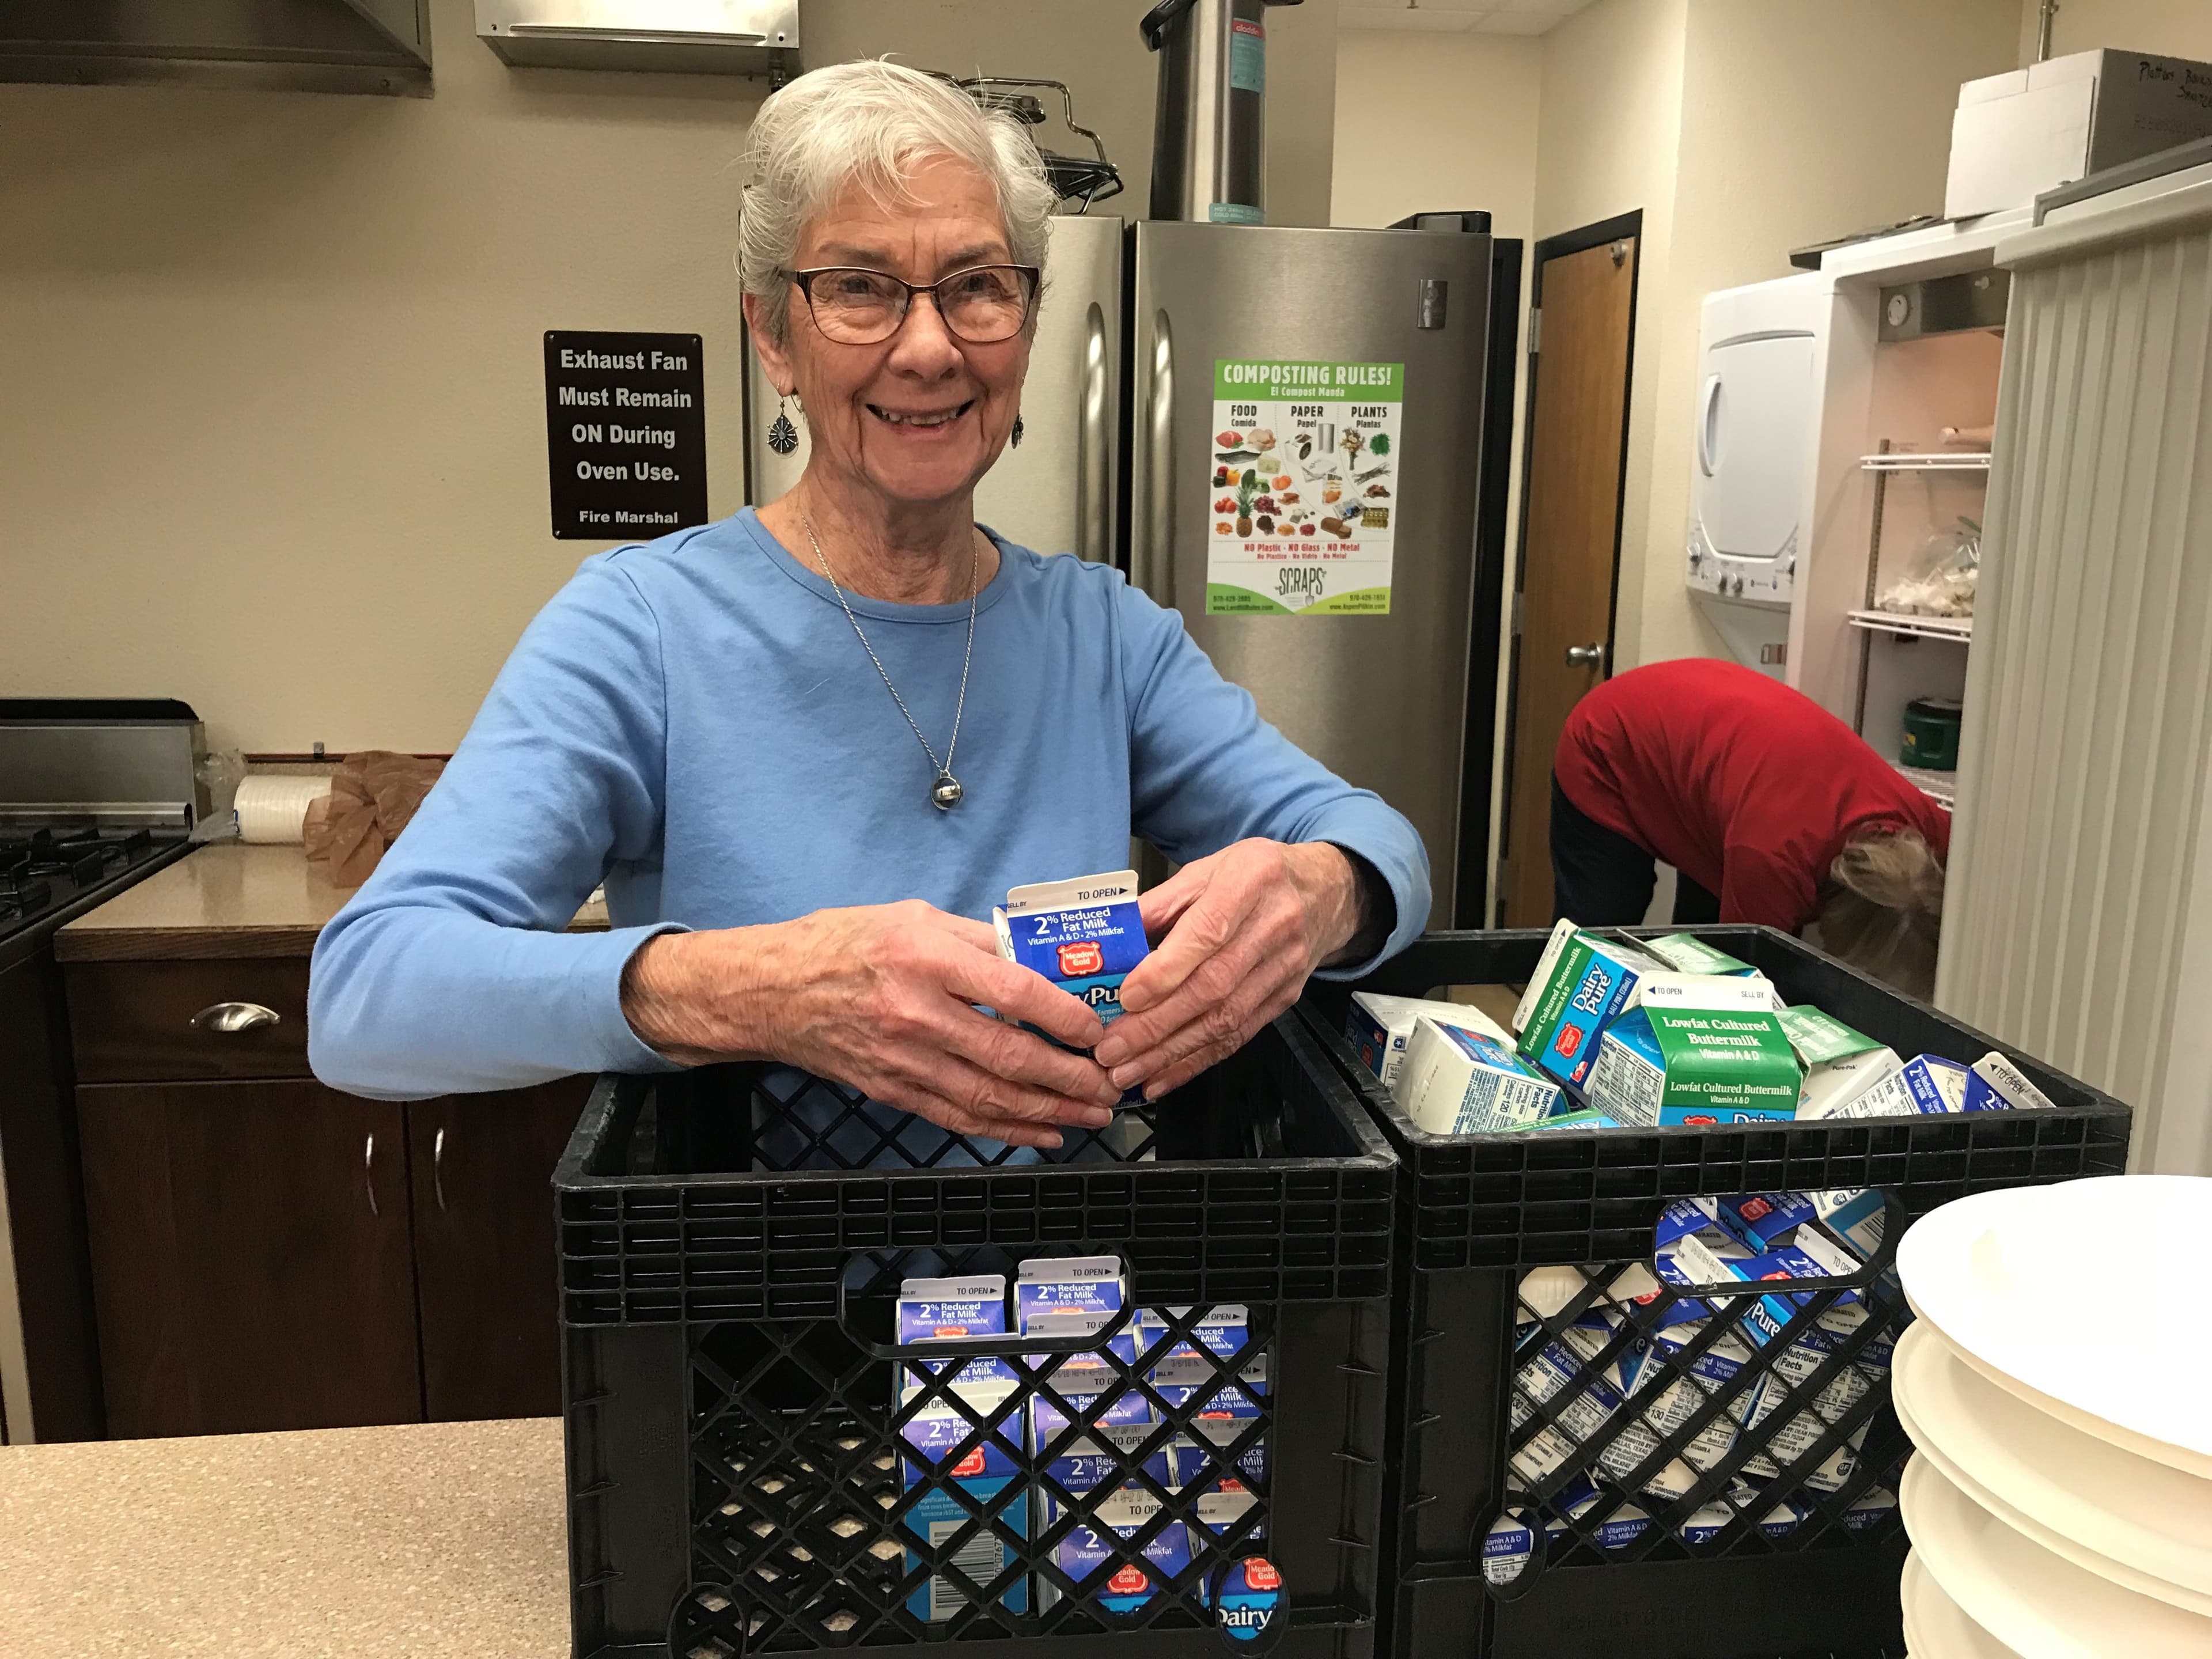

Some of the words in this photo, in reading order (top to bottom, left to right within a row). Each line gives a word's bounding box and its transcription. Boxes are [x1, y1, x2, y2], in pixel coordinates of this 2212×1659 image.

[560, 349, 645, 370] Exhaust
[651, 351, 688, 370] Fan
[1224, 365, 1329, 384] COMPOSTING
[1335, 366, 1392, 385] RULES!
[559, 387, 609, 406] Must
[616, 388, 692, 408] Remain
[1271, 388, 1279, 396] El
[1282, 388, 1316, 397] Compost
[1319, 388, 1344, 397] Manda
[1231, 405, 1257, 416] FOOD
[1291, 406, 1324, 417] PAPER
[1351, 407, 1387, 418] PLANTS
[1231, 419, 1256, 427] Comida
[1297, 420, 1316, 428] Papel
[1356, 421, 1381, 429] Plantas
[572, 424, 602, 442] ON
[609, 425, 676, 449] During
[577, 461, 628, 480] Oven
[634, 462, 680, 481] Use.
[579, 510, 610, 523] Fire
[615, 511, 678, 524] Marshal
[1244, 544, 1255, 552] NO
[1257, 544, 1281, 552] Plastic
[1288, 544, 1298, 552] NO
[1301, 544, 1320, 552] Glass
[1327, 543, 1338, 552] NO
[1340, 543, 1359, 552] Metal
[1279, 567, 1324, 596] SCRAPS
[1078, 891, 1090, 900] TO
[1092, 889, 1117, 899] OPEN
[1033, 915, 1059, 935] 2%
[1060, 908, 1111, 923] Reduced
[1062, 923, 1081, 932] Fat
[1083, 919, 1108, 930] Milk
[1028, 935, 1058, 946] Vitamin
[1059, 934, 1065, 942] A
[1099, 926, 1124, 936] Milkfat
[1555, 937, 1563, 950] OPEN
[1065, 951, 1094, 960] Meadow
[1073, 958, 1090, 967] Gold
[1572, 964, 1603, 1011] Dairy
[1525, 1023, 1543, 1051] Lowfat
[1539, 988, 1559, 1024] Cultured
[1555, 946, 1582, 990] Buttermilk
[1585, 975, 1611, 1015] Pure
[1550, 1001, 1563, 1021] Vitamin
[1662, 1017, 1710, 1029] Lowfat
[1711, 1020, 1771, 1031] Cultured
[1687, 1033, 1763, 1047] Buttermilk
[1699, 1049, 1734, 1060] Vitamin
[1734, 1050, 1743, 1060] A
[1743, 1051, 1752, 1060] &
[1753, 1051, 1760, 1060] D
[1506, 1080, 1516, 1100] Calories
[1671, 1082, 1700, 1092] Lowfat
[1703, 1083, 1742, 1094] Cultured
[1744, 1084, 1792, 1095] Buttermilk
[1921, 1075, 1937, 1098] Reduced
[2005, 1077, 2024, 1094] OPEN
[1516, 1086, 1524, 1104] carton
[1521, 1085, 1531, 1103] Serving
[1531, 1087, 1544, 1108] Facts
[1710, 1096, 1733, 1104] Vitamin
[1499, 1100, 1510, 1113] 120
[1834, 1256, 1841, 1267] TO
[1037, 1286, 1056, 1299] 2%
[1058, 1283, 1096, 1291] Reduced
[920, 1304, 939, 1317] 2%
[941, 1302, 980, 1310] Reduced
[1781, 1358, 1802, 1370] Facts
[972, 1368, 993, 1376] Milk
[1220, 1392, 1242, 1400] Milk
[1070, 1459, 1093, 1475] 2%
[1062, 1477, 1090, 1485] Vitamin
[1130, 1506, 1141, 1514] TO
[1076, 1551, 1104, 1559] Vitamin
[1146, 1547, 1172, 1556] Milkfat
[1118, 1575, 1137, 1583] Gold
